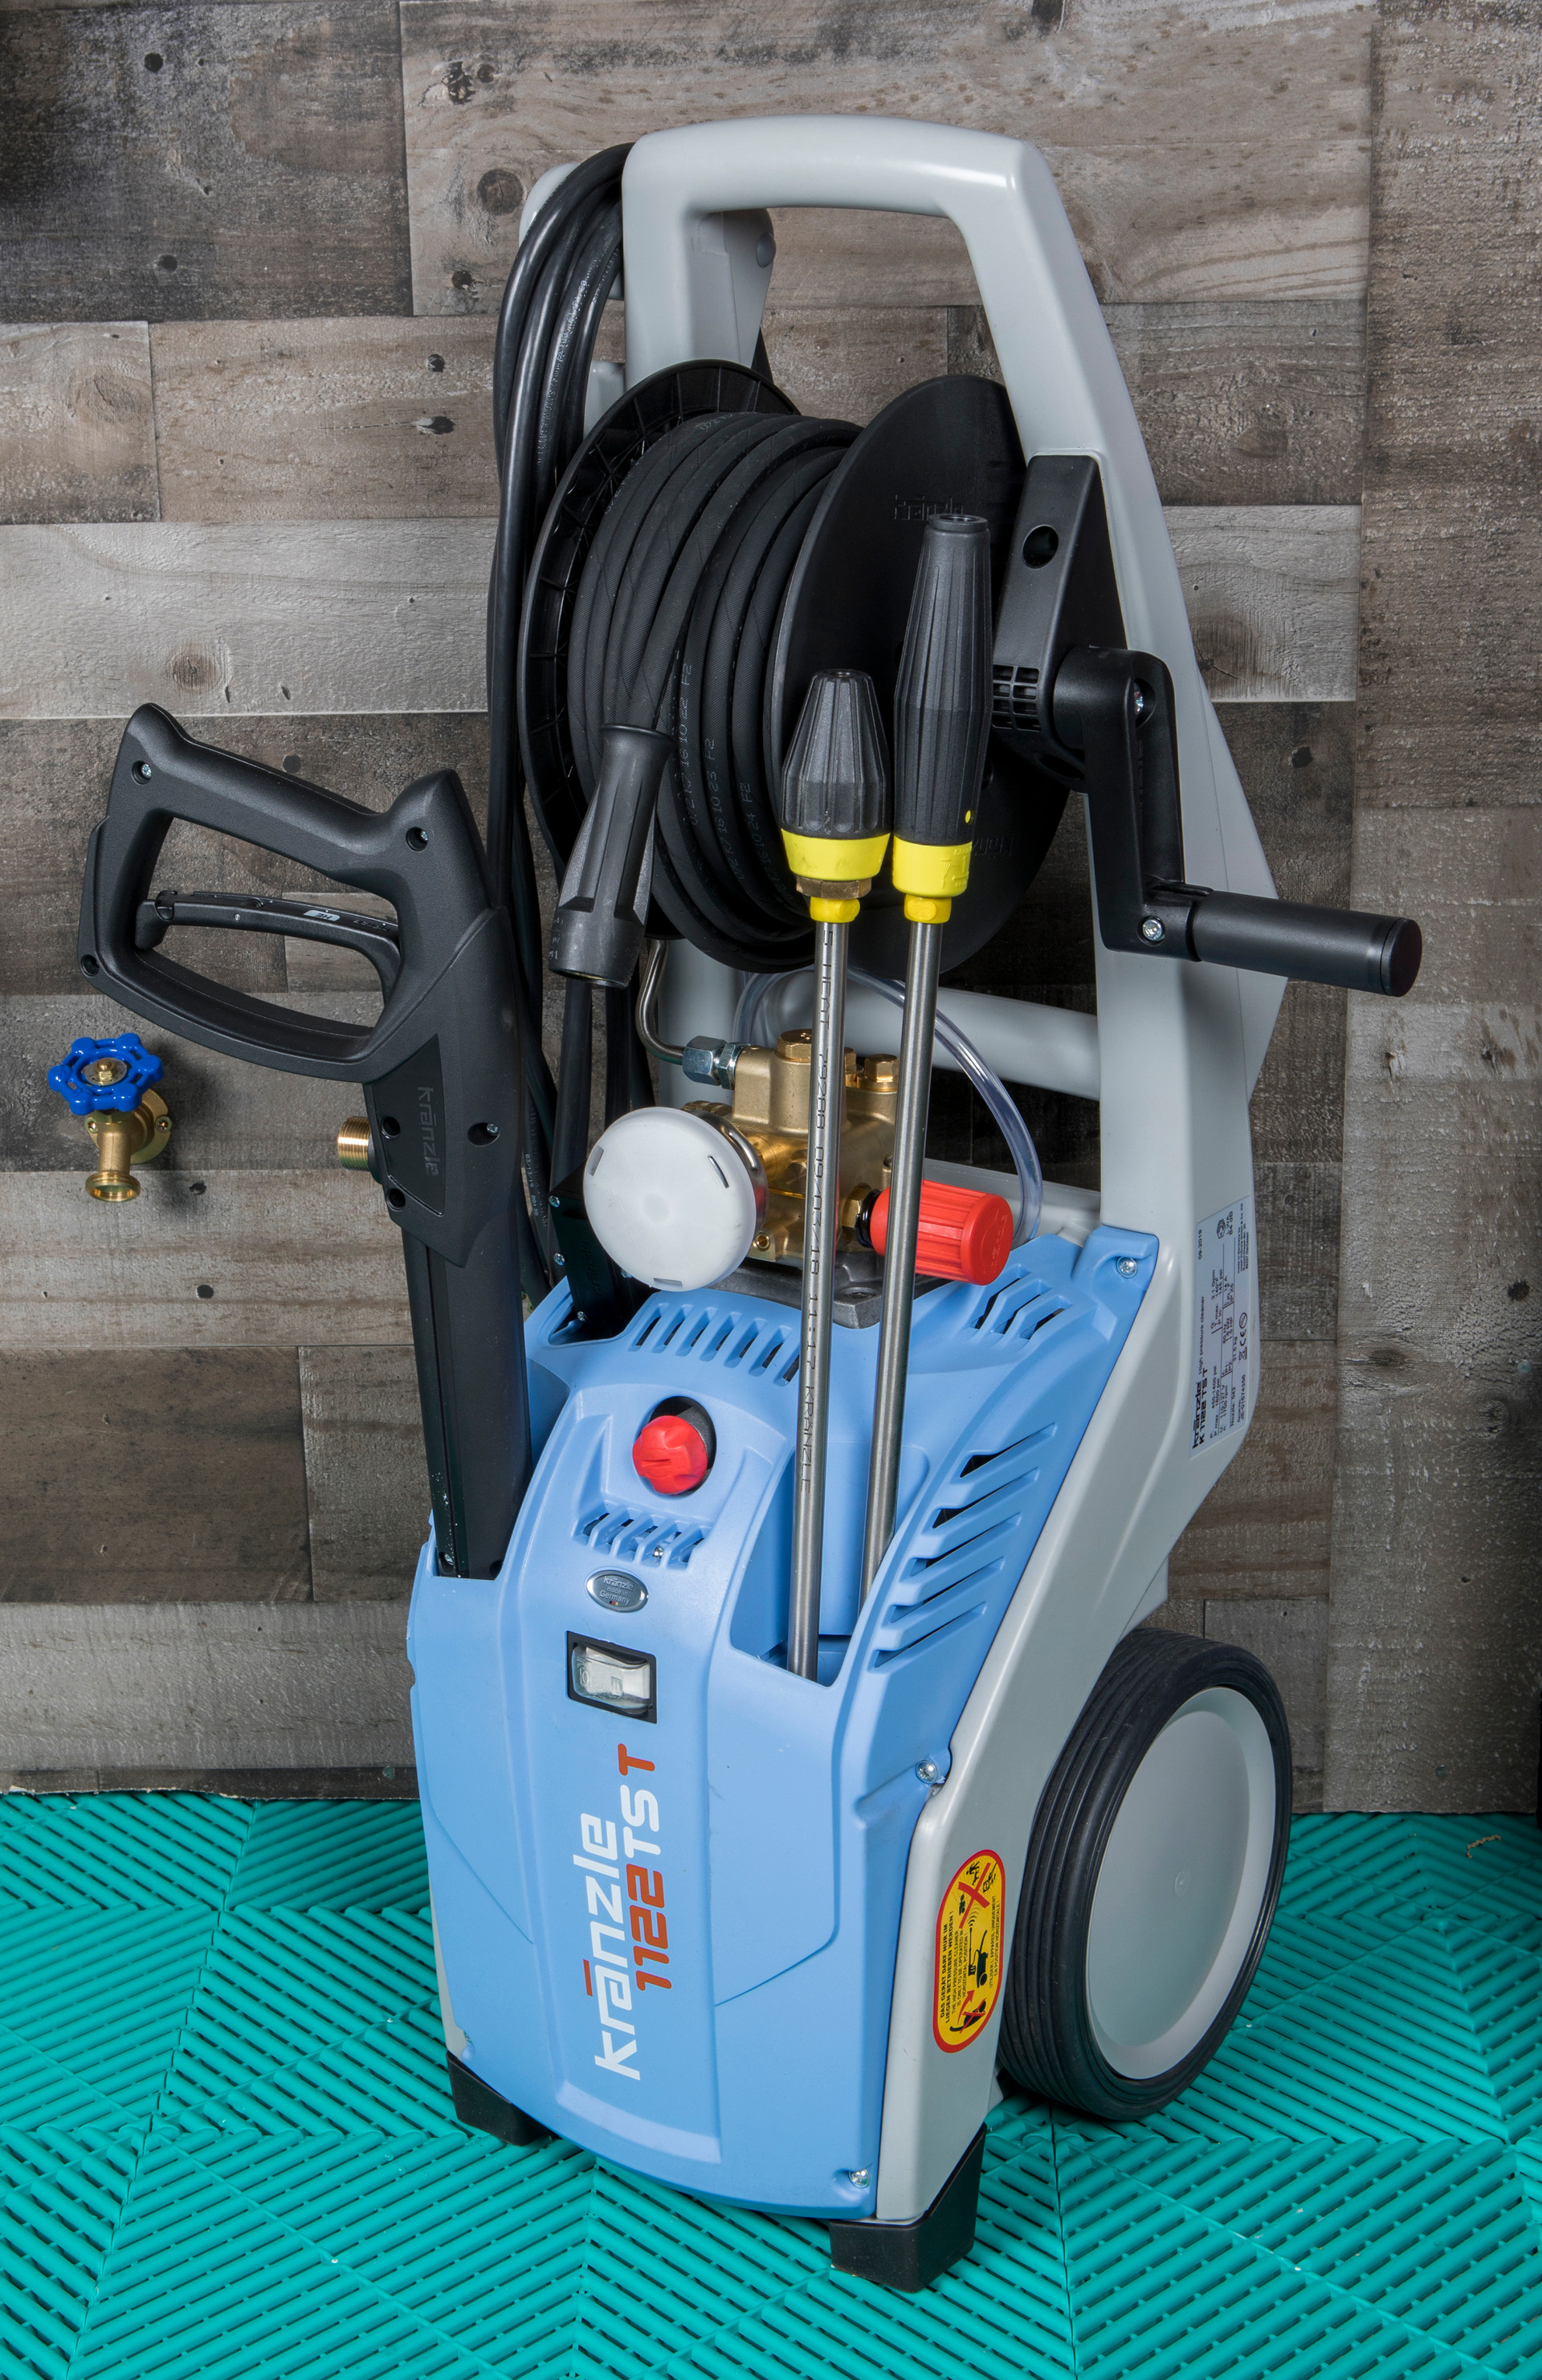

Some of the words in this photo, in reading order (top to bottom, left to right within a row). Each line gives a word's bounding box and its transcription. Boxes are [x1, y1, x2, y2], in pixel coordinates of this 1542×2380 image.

[820, 963, 832, 1031] HEAT
[810, 1145, 825, 1276] 09/03/18
[807, 1292, 819, 1370] 11:17
[1199, 1433, 1205, 1445] K
[599, 1590, 630, 1606] Germany
[617, 1743, 655, 1776] T
[620, 1784, 661, 1860] TS
[573, 1813, 640, 2080] kränzle
[626, 1864, 672, 1991] 1122
